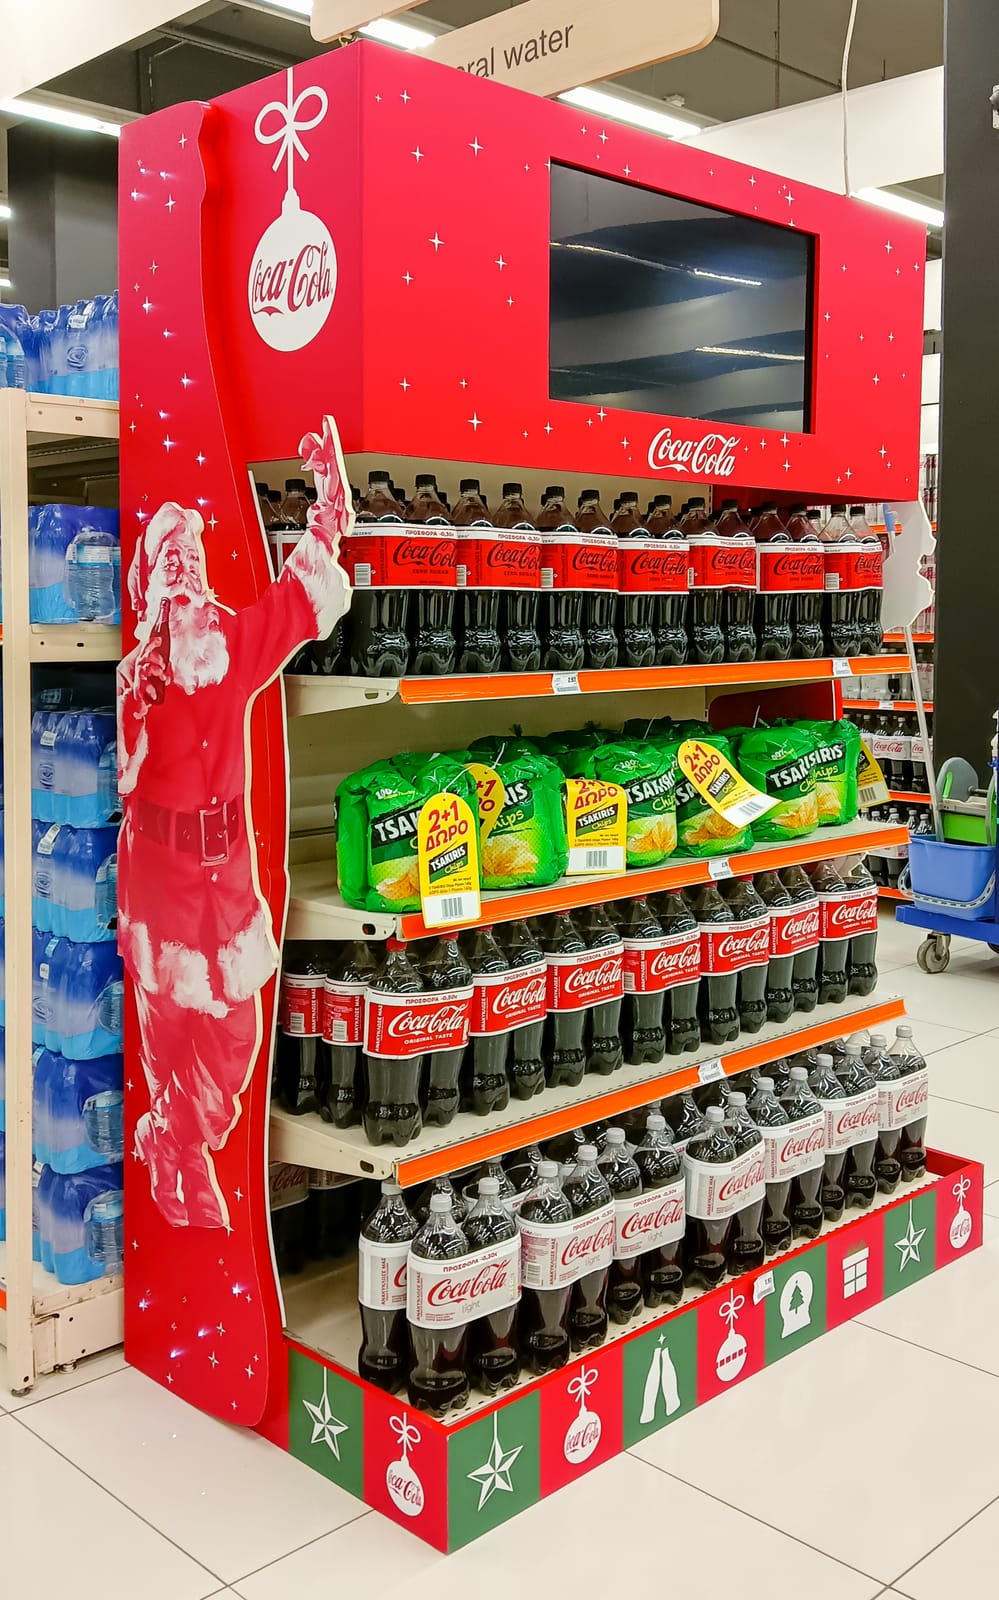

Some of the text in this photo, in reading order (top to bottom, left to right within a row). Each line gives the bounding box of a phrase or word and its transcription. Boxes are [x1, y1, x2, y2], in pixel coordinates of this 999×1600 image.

[503, 24, 574, 70] water
[251, 241, 332, 317] Coca-Cola
[648, 428, 741, 476] Coca-Cola
[393, 538, 456, 567] Coca-Col
[487, 542, 541, 570] Coca-Col
[572, 547, 618, 571] Coca-Co
[684, 744, 708, 772] 2+1
[694, 754, 720, 784] ΔΩΡΟ
[574, 786, 618, 810] ΔΩΡΟ
[428, 800, 459, 834] 2+1
[578, 806, 616, 827] TSAKIRIS
[426, 820, 468, 852] ΔΩΡΟ
[430, 846, 466, 871] TSAKIRIS
[564, 958, 623, 993] Coca-Cola
[387, 1003, 468, 1037] Coca-Cola
[404, 1032, 453, 1045] ORIGINAL TASTE
[621, 1195, 684, 1240] Coca-Cola
[561, 1219, 614, 1266] Coca-Col
[427, 1259, 511, 1307] Coca-Cola
[461, 1300, 481, 1314] light
